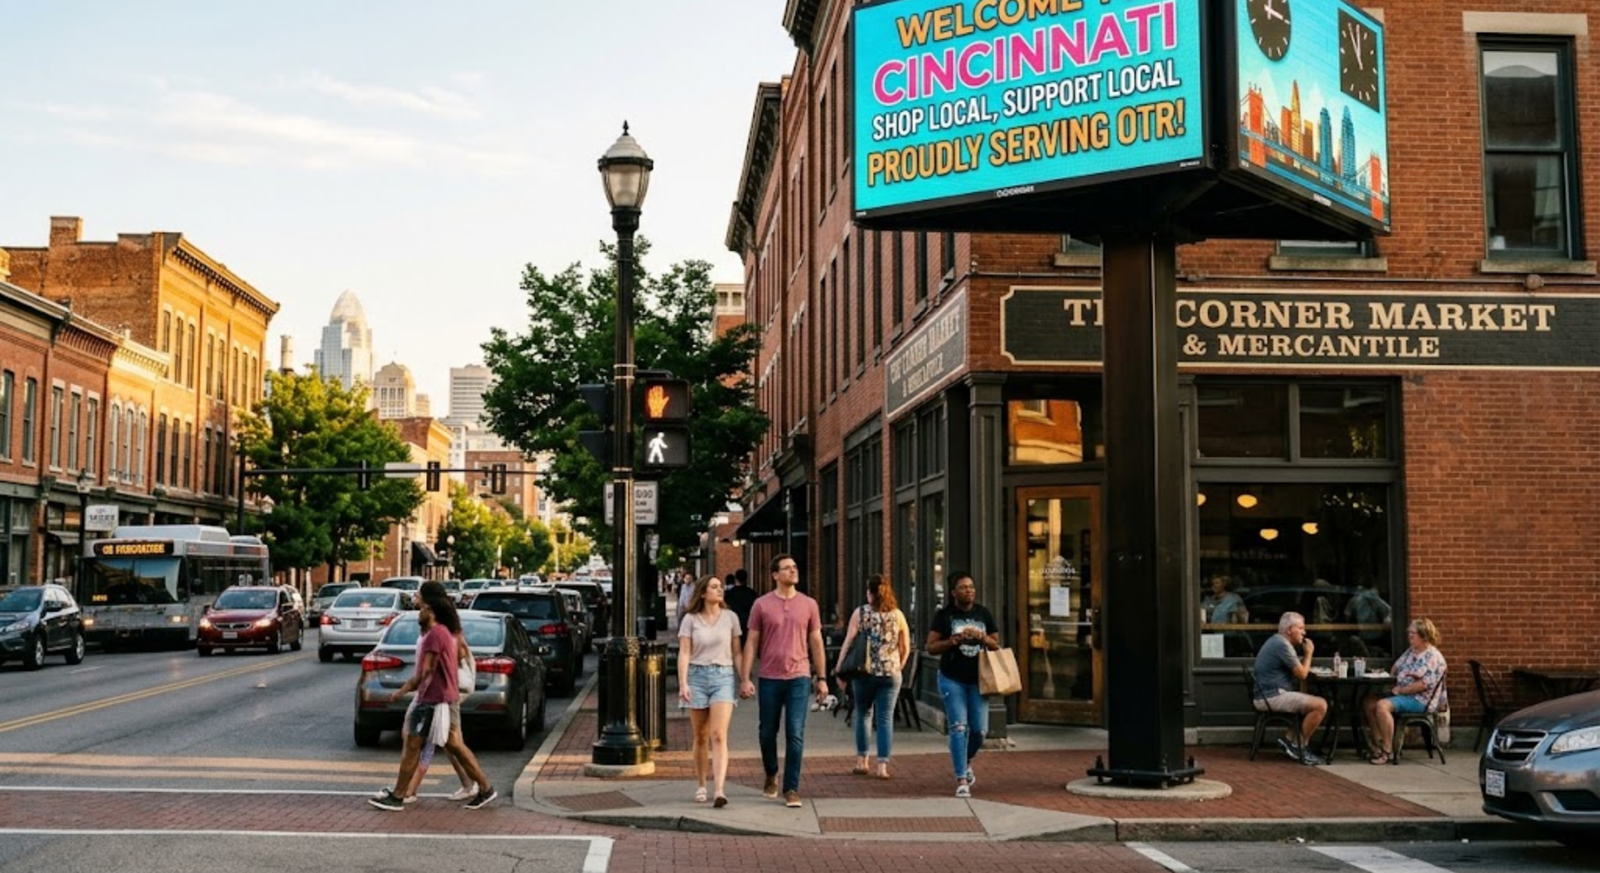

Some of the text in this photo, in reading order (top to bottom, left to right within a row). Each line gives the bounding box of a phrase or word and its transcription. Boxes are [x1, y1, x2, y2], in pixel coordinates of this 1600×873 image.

[873, 1, 1177, 105] CINCINNATI
[872, 59, 1181, 141] SHOP LOCAL, SUPPORT LOCAL
[867, 100, 1186, 187] PROUDLY SERVING OTR!
[1176, 299, 1556, 332] CORNER MARKET
[1182, 334, 1440, 358] & MERCANTILE
